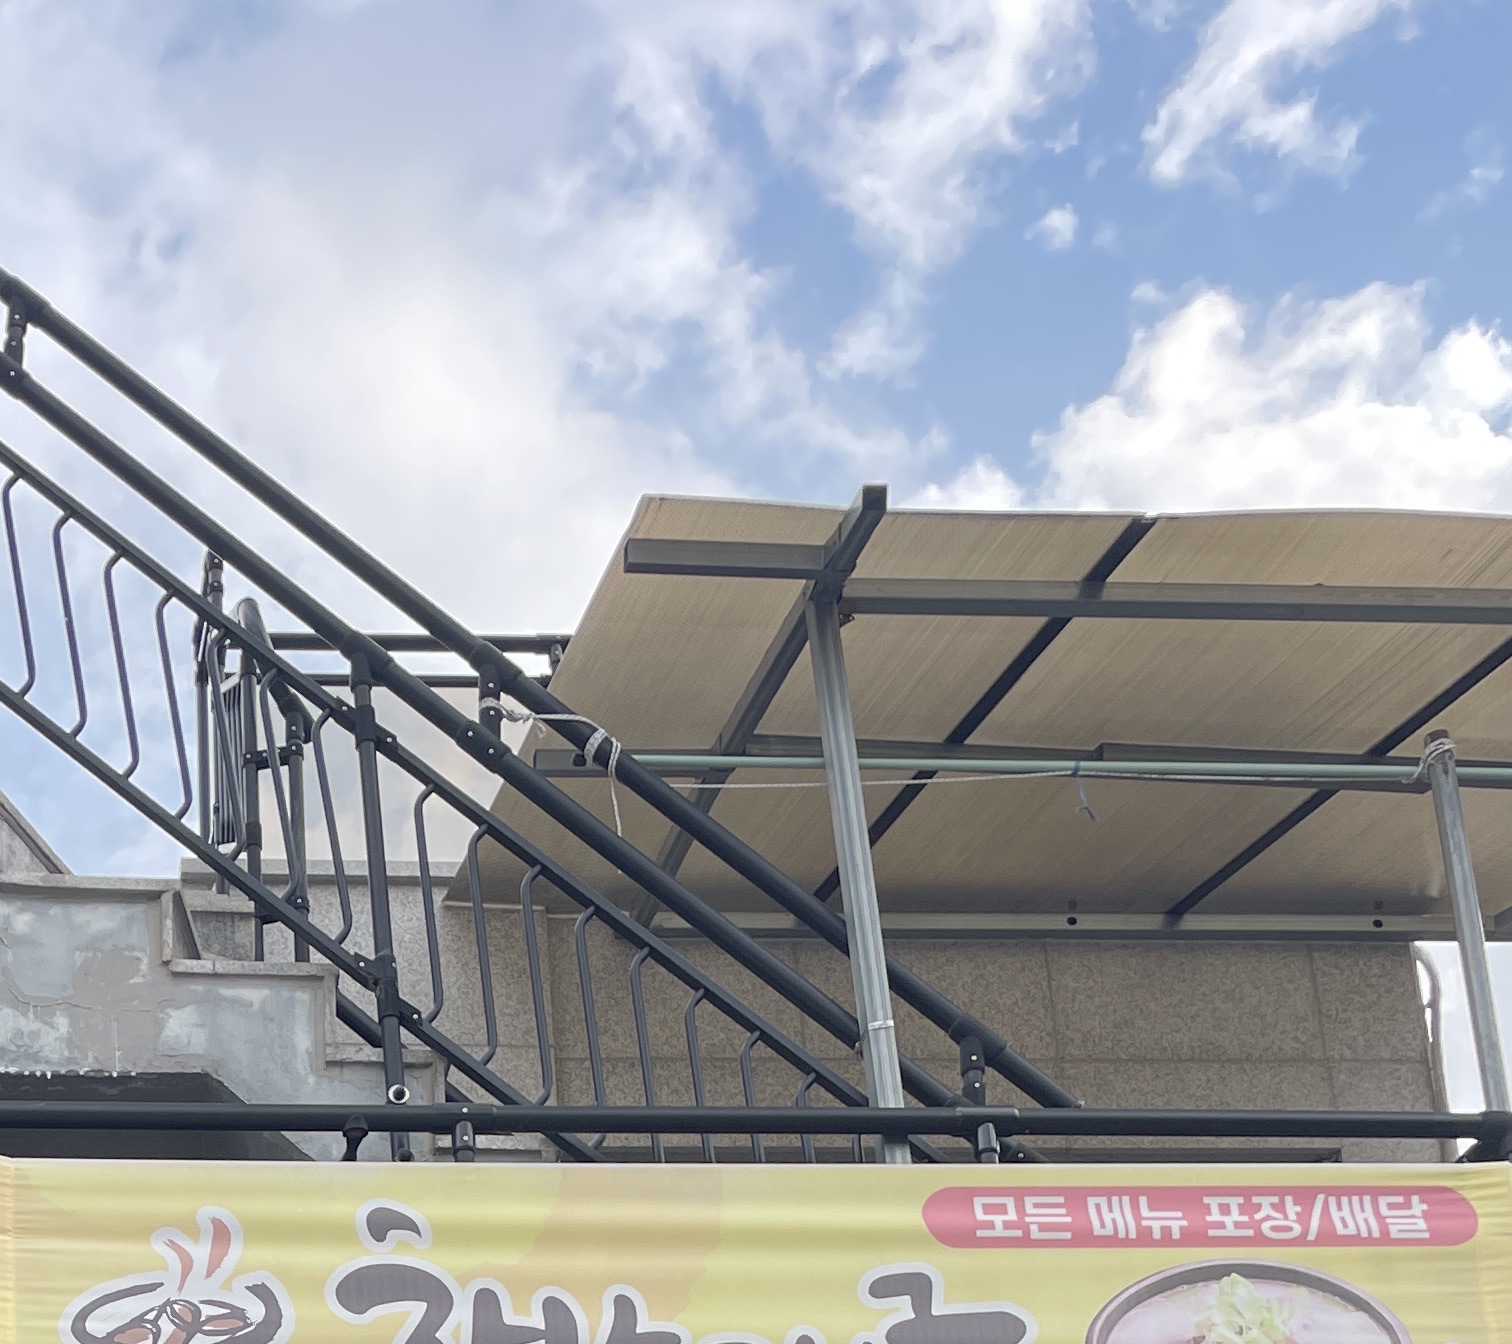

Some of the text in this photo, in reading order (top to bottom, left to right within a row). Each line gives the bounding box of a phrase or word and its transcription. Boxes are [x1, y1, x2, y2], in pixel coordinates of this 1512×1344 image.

[972, 1192, 1431, 1242] 모든 메뉴 포장/배달
